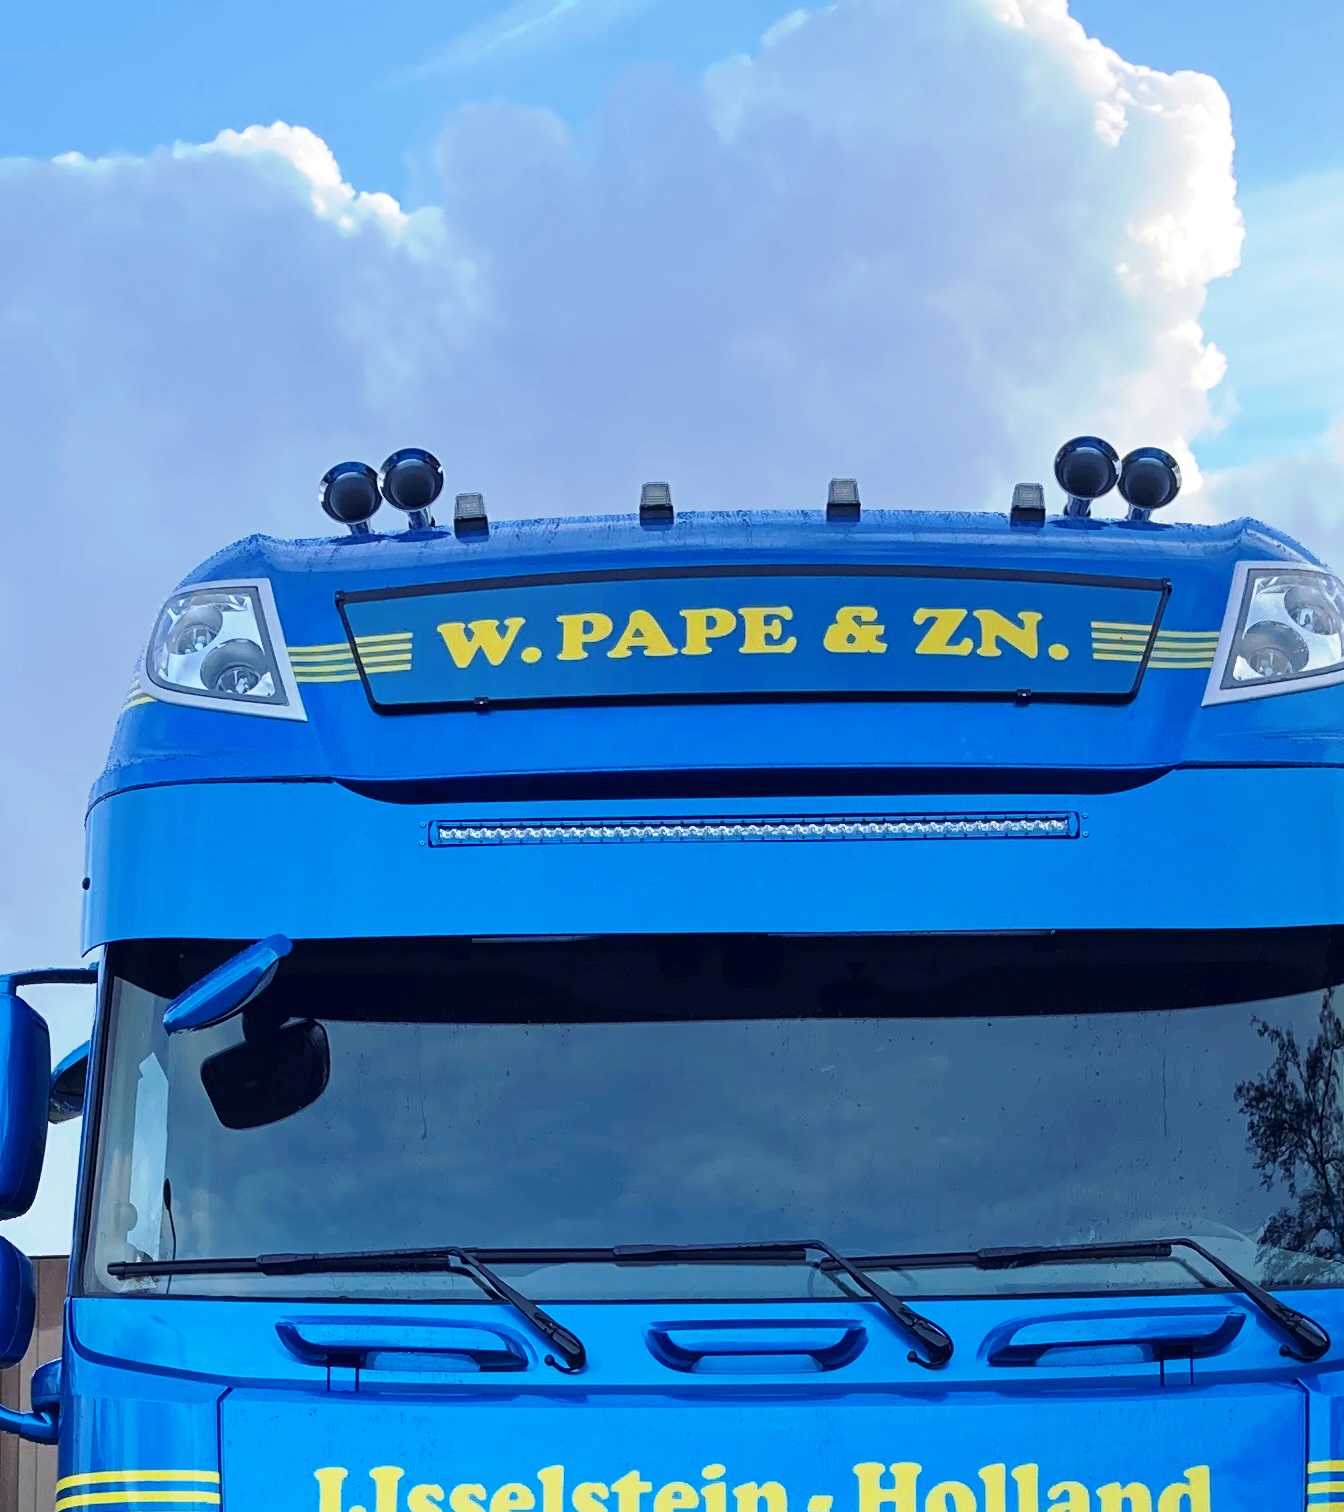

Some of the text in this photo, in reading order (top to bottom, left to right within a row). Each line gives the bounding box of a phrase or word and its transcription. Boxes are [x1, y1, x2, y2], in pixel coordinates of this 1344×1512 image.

[559, 607, 796, 659] PAPE
[824, 606, 886, 652] &
[914, 608, 1068, 659] ZN.
[807, 1495, 834, 1512] -
